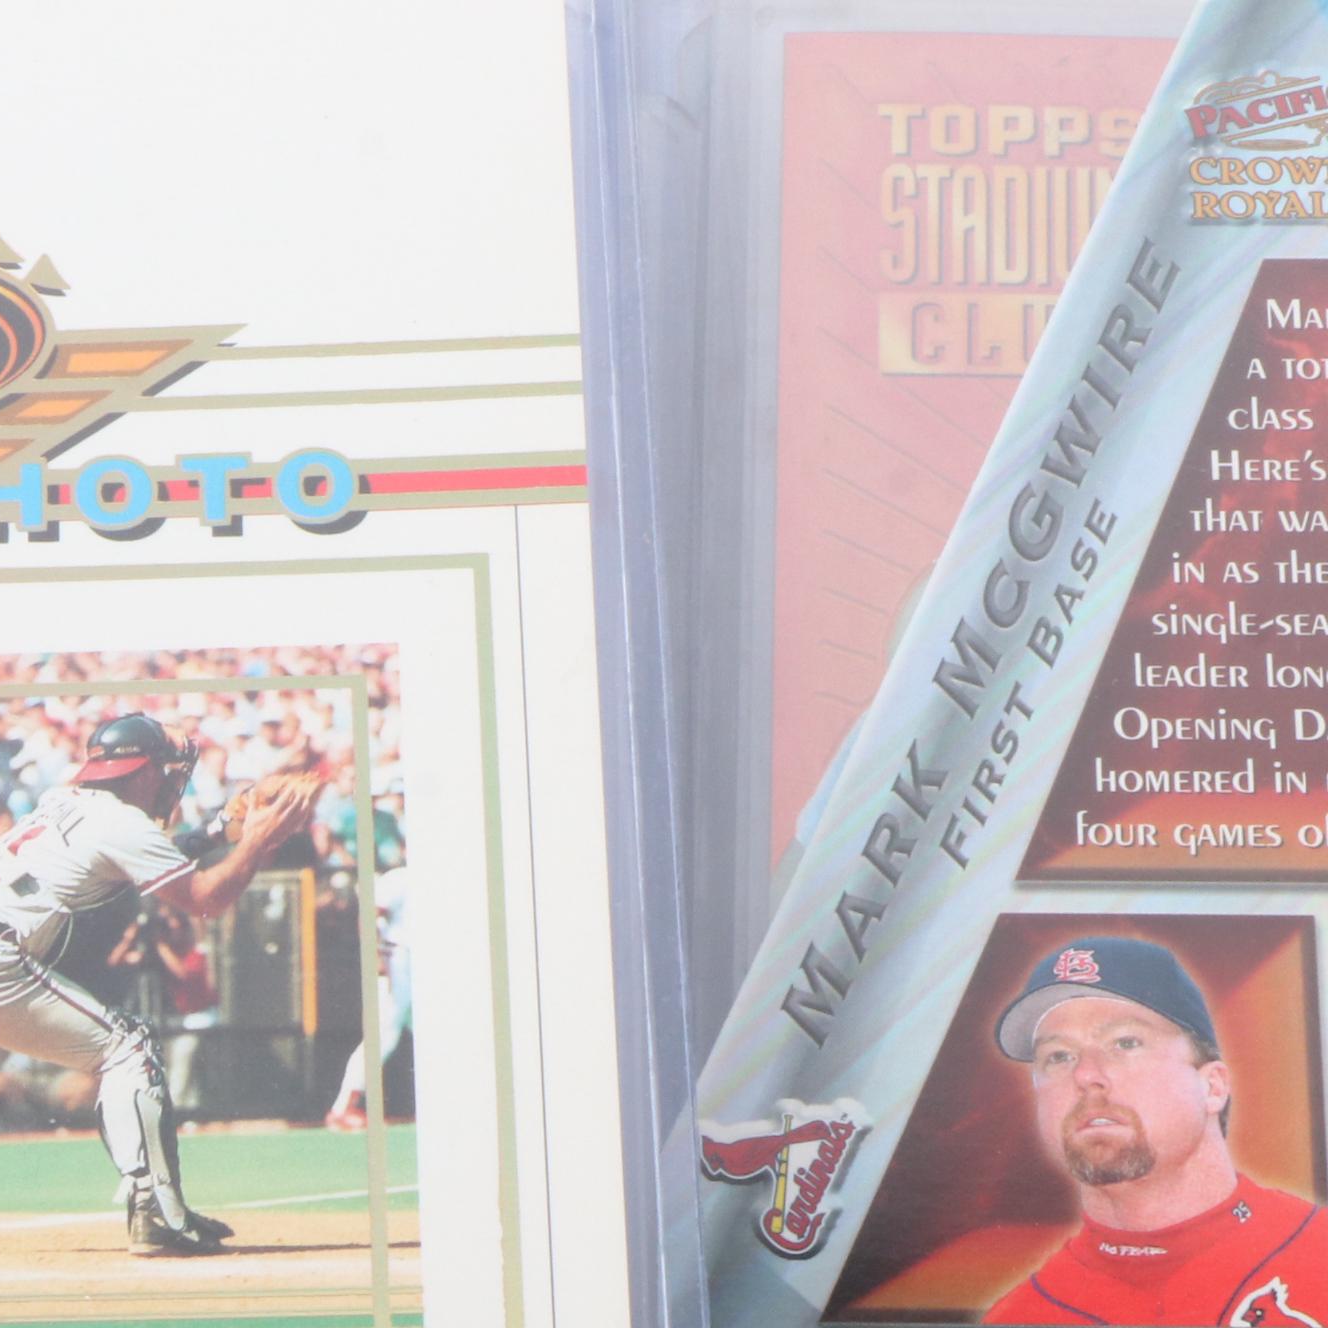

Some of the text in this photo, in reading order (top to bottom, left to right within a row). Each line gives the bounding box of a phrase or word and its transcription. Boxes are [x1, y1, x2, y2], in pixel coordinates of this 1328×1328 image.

[1184, 85, 1328, 140] PACIFI
[1189, 156, 1328, 186] CROW
[879, 164, 1116, 286] STADIU
[780, 236, 1181, 1050] MARK MCGWIRE
[939, 498, 1119, 871] FIRST BASE
[762, 1120, 857, 1253] Cardinals
